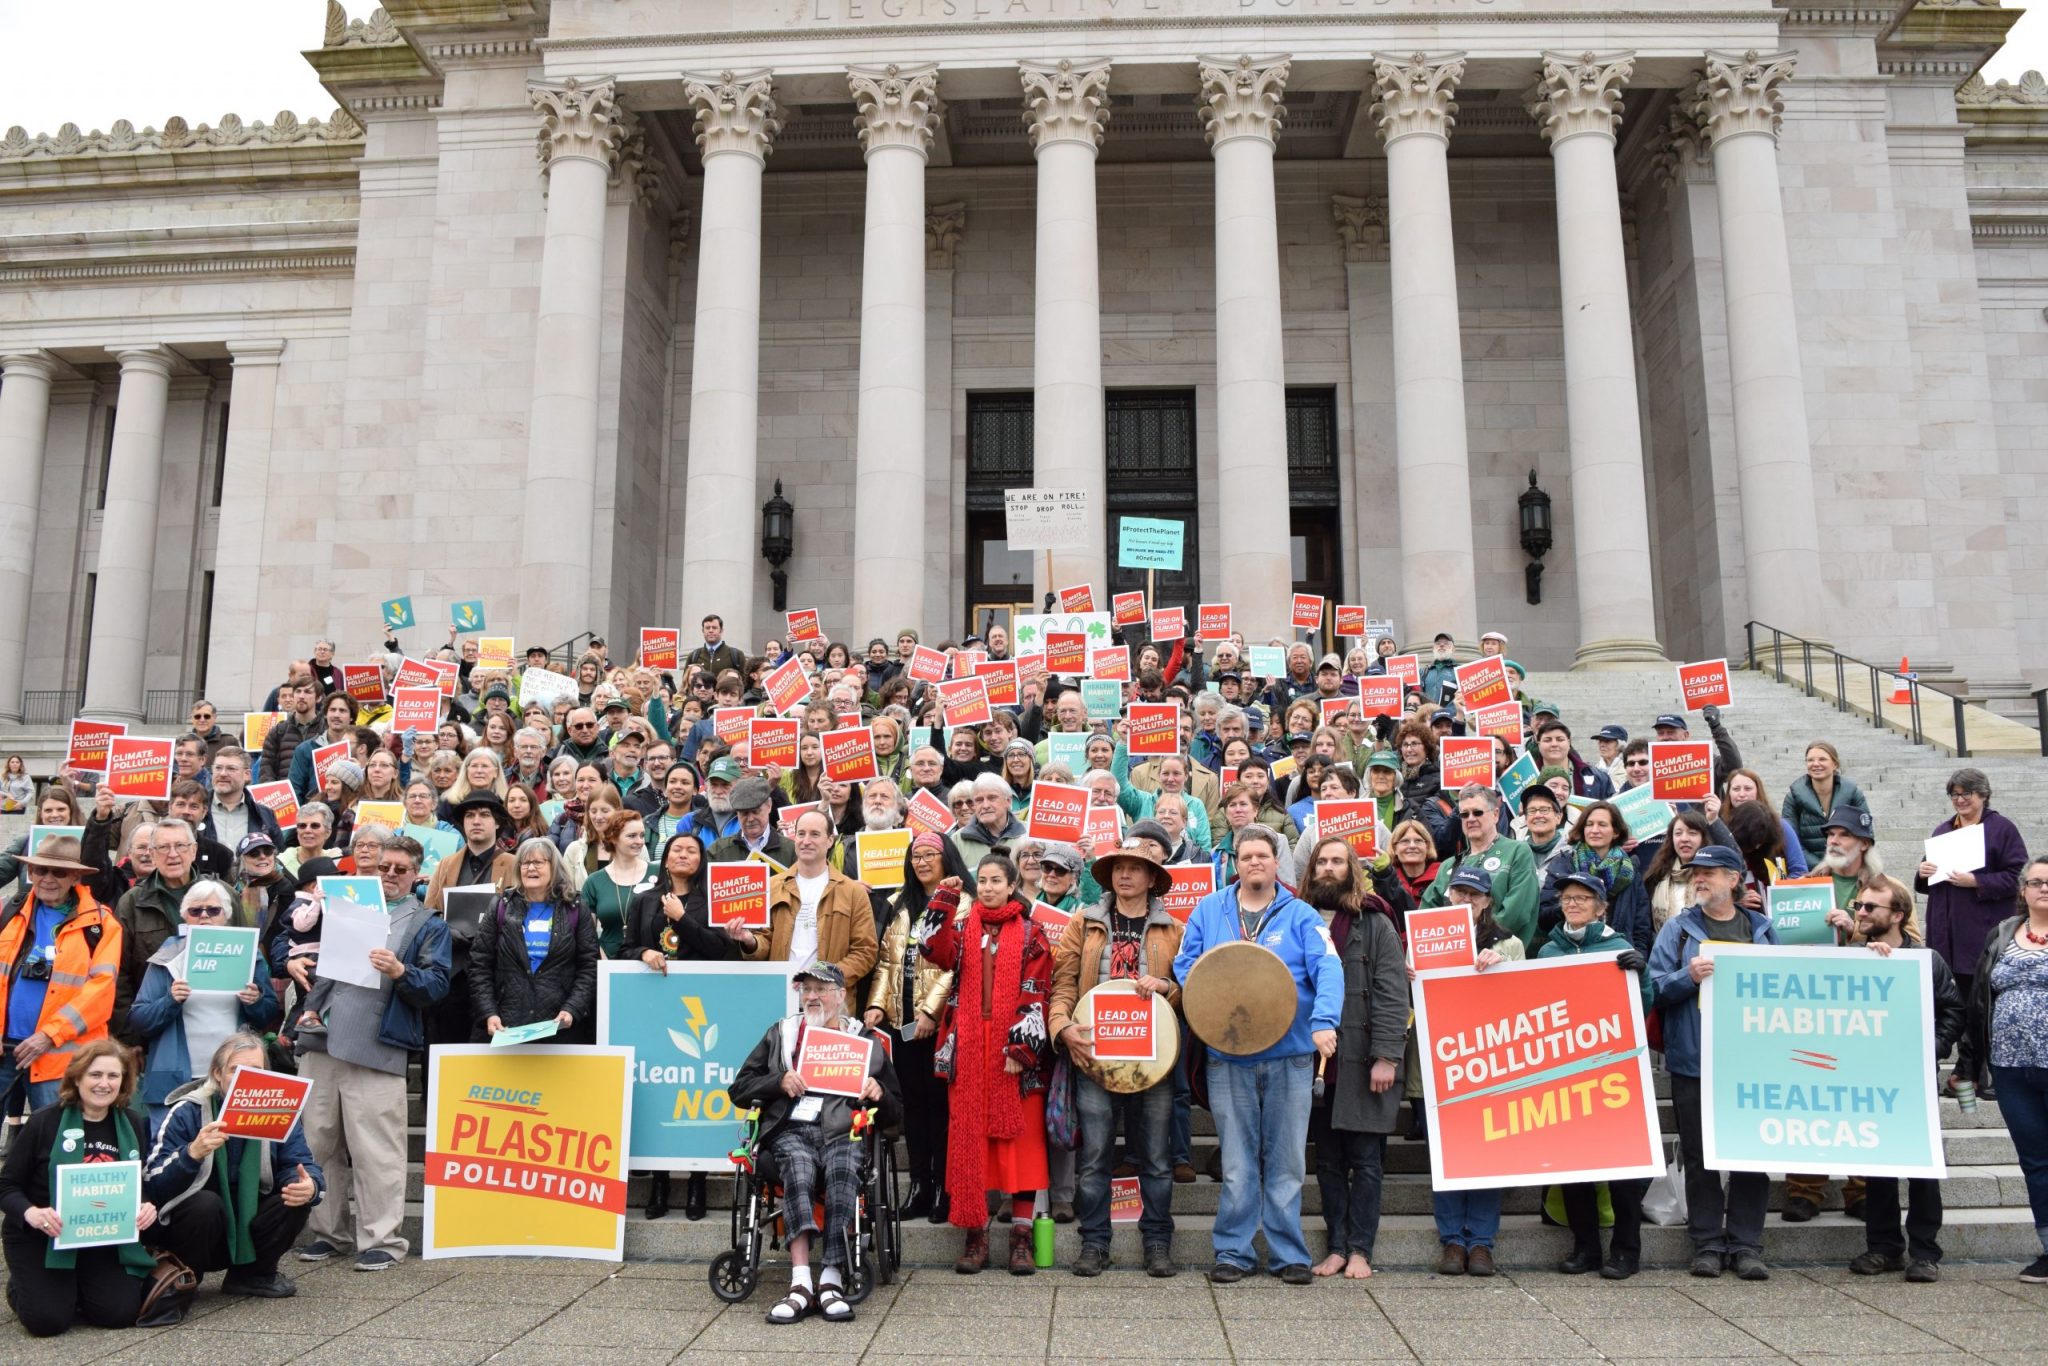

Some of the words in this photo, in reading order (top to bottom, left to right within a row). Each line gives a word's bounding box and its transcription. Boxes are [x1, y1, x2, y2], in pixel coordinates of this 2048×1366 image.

[1295, 610, 1319, 618] CLIMATE
[643, 637, 667, 646] CLIMATE
[644, 641, 675, 651] POLLUTION
[1047, 639, 1074, 649] CLIMATE
[1048, 643, 1084, 654] POLLUTION
[649, 651, 675, 661] LIMITS
[916, 654, 933, 663] LEAD
[1054, 655, 1083, 665] LIMITS
[400, 669, 427, 678] CLIMATE
[914, 663, 940, 675] CLIMATE
[346, 672, 370, 681] CLIMATE
[347, 675, 379, 686] POLLUTION
[399, 675, 434, 685] POLLUTION
[770, 671, 790, 693] CLIMATE
[773, 669, 799, 697] POLLUTION
[1461, 667, 1489, 687] CLIMATE
[1463, 669, 1502, 692] POLLUTION
[1684, 676, 1706, 686] LEAD
[1709, 673, 1723, 681] ON
[354, 685, 380, 695] LIMITS
[780, 679, 804, 703] LIMITS
[1472, 682, 1505, 702] LIMITS
[1687, 684, 1724, 696] CLIMATE
[1365, 696, 1398, 705] CLIMATE
[398, 711, 433, 719] CLIMATE
[954, 701, 985, 718] LIMITS
[1479, 709, 1507, 720] CLIMATE
[717, 716, 743, 726] CLIMATE
[717, 720, 749, 731] POLLUTIO
[1132, 713, 1163, 726] CLIMATE
[1132, 718, 1174, 733] POLLUTION
[1481, 713, 1519, 727] POLLUTION
[723, 730, 749, 742] LIMIT
[752, 728, 783, 740] CLIMATE
[753, 733, 795, 746] POLLUTION
[1139, 731, 1175, 745] LIMITS
[760, 746, 794, 758] LIMITS
[825, 738, 857, 756] CLIMATE
[827, 742, 869, 761] POLLUTION
[1444, 748, 1478, 759] CLIMATE
[113, 750, 153, 761] CLIMATE
[1446, 752, 1489, 766] POLLUTION
[1654, 753, 1693, 768] CLIMATE
[113, 756, 166, 770] POLLUTION
[836, 756, 871, 774] LIMITS
[1656, 758, 1707, 776] POLLUTION
[120, 771, 165, 785] LIMITS
[1453, 765, 1489, 778] LIMITS
[1664, 774, 1707, 791] LIMITS
[911, 801, 941, 820] CLIMATE
[1036, 798, 1064, 809] LEAD
[1067, 802, 1082, 811] ON
[910, 804, 947, 829] POLLUTION
[1035, 812, 1080, 826] CLIMATE
[1320, 811, 1358, 827] CLIMATE
[1322, 817, 1371, 834] POLLUTION
[712, 876, 750, 890] CLIMATE
[1169, 882, 1189, 892] EAD
[1192, 881, 1208, 891] ON
[714, 882, 763, 899] POLLUTION
[722, 898, 763, 914] LIMITS
[1777, 900, 1822, 911] CLEAN
[1777, 917, 1800, 928] AIR
[1415, 927, 1444, 939] LEAD
[1448, 924, 1465, 935] ON
[195, 942, 243, 955] CLEAN
[1416, 939, 1466, 953] CLIMATE
[192, 960, 217, 970] AIR
[1736, 973, 1895, 1002] HEALTHY
[1098, 1011, 1126, 1020] LEAD
[1131, 1011, 1147, 1020] ON
[1743, 1007, 1888, 1037] HABITAT
[1099, 1026, 1147, 1036] CLIMATE
[1436, 1000, 1569, 1062] CLIMATE
[807, 1044, 850, 1052] CLIMATE
[1446, 1014, 1621, 1091] POLLUTION
[807, 1052, 863, 1060] POLLUTION
[813, 1066, 861, 1077] LIMITS
[234, 1089, 284, 1098] CLIMATE
[468, 1086, 542, 1106] REDUCE
[1737, 1083, 1899, 1114] HEALTHY
[232, 1098, 298, 1107] POLLUTION
[1483, 1073, 1630, 1142] LIMITS
[236, 1115, 291, 1125] LIMITS
[1760, 1119, 1879, 1148] ORCAS
[450, 1113, 612, 1173] PLASTIC
[71, 1172, 127, 1183] HEALTHY
[444, 1161, 605, 1203] POLLUTION
[72, 1184, 125, 1197] HABITAT
[70, 1212, 127, 1224] HEALTHY
[76, 1225, 118, 1237] ORCAS
